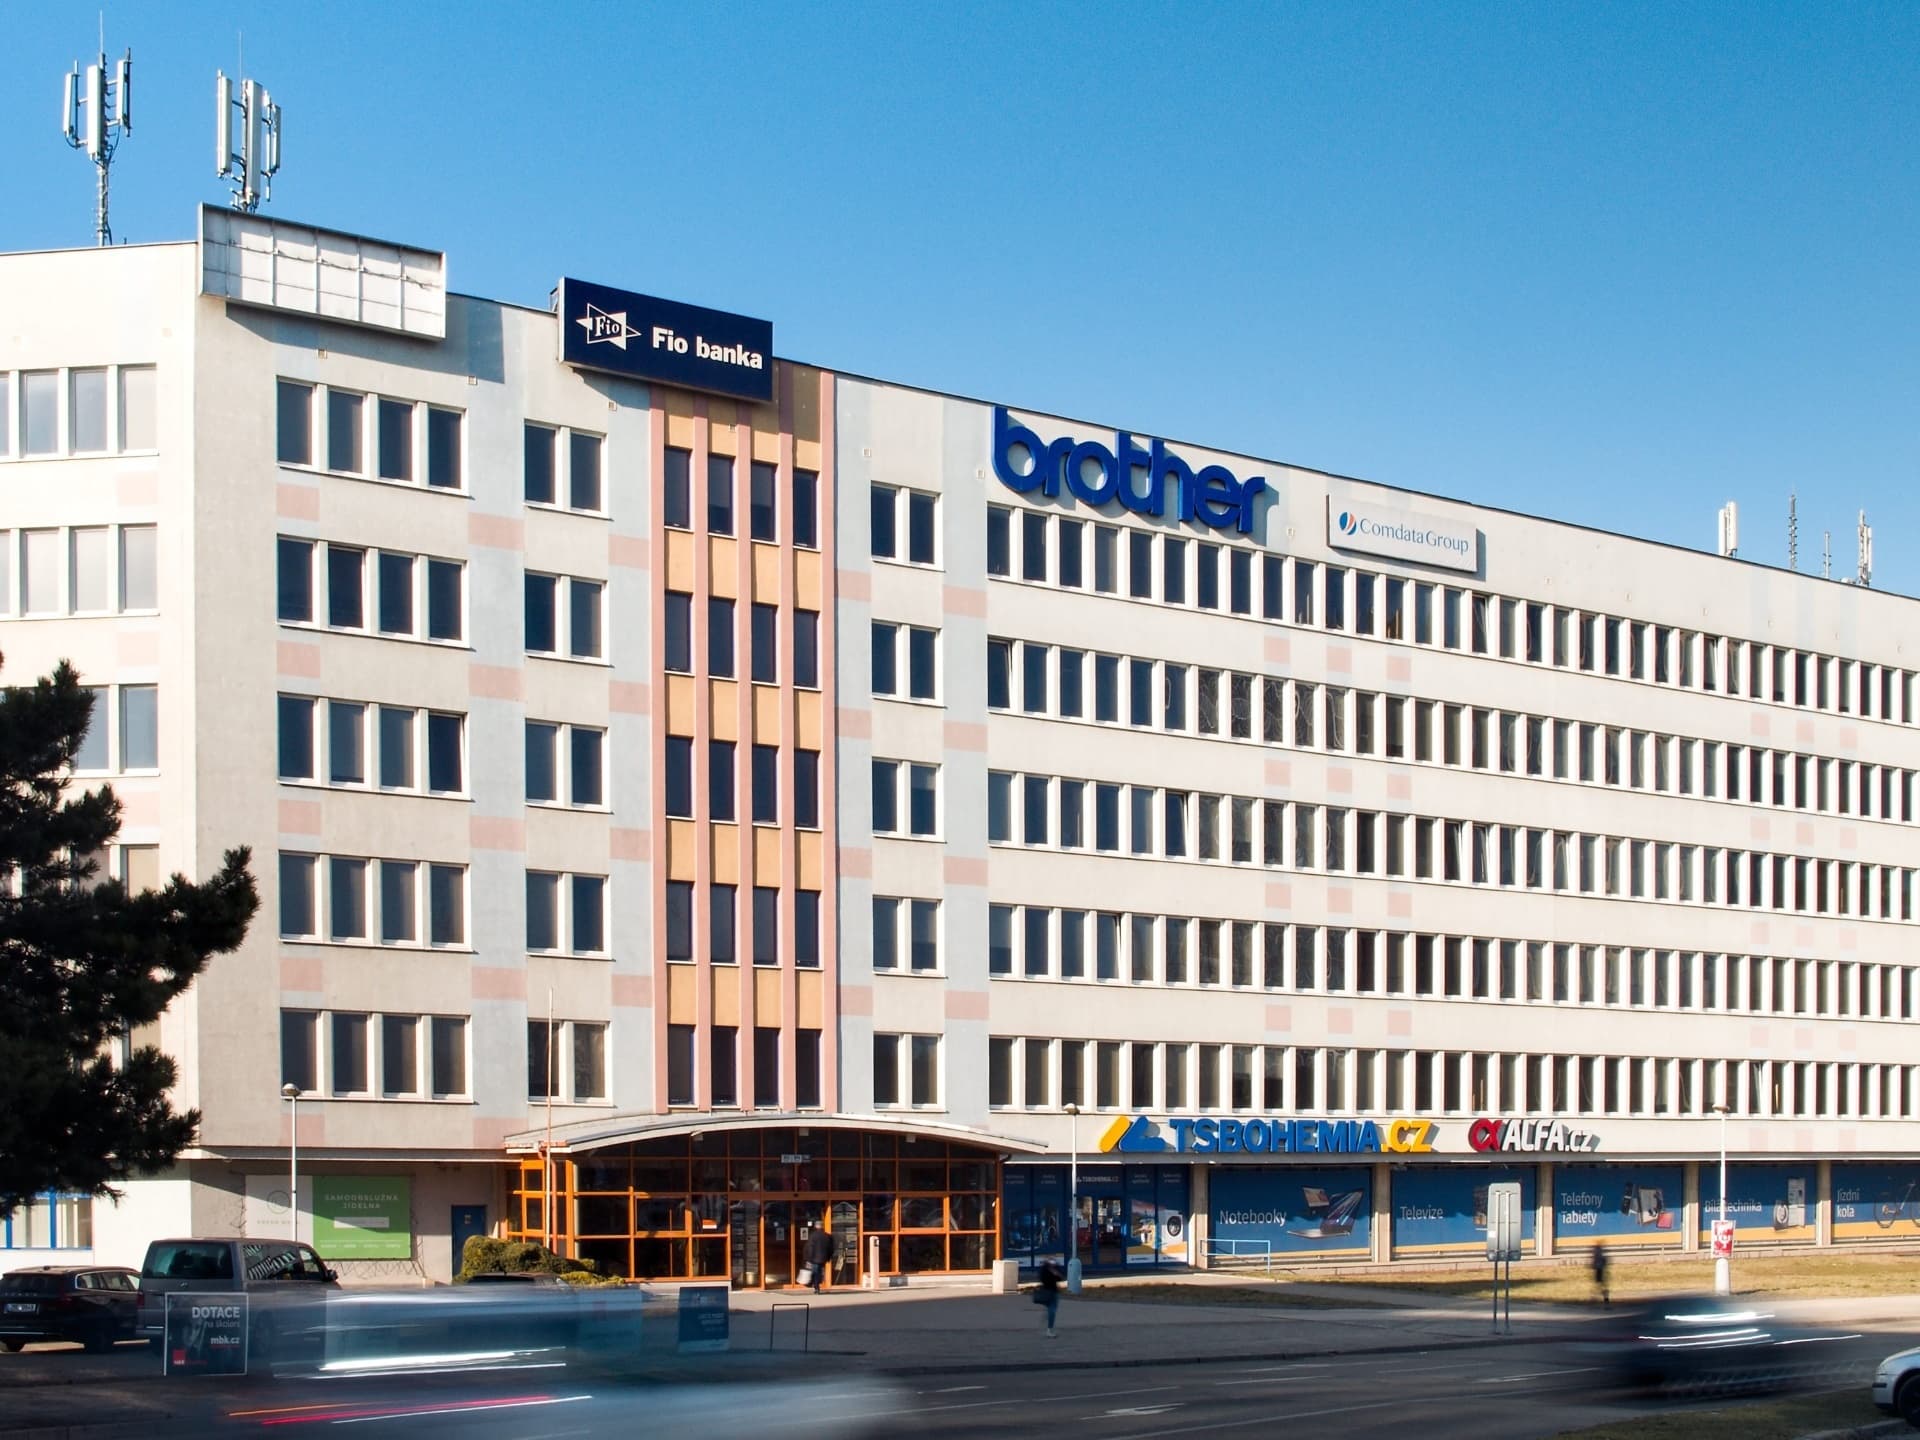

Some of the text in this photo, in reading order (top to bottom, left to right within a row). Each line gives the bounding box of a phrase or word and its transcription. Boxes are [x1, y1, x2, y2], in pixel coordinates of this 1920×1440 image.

[594, 315, 620, 337] Fio
[652, 326, 763, 370] Fio banka
[993, 405, 1266, 534] brother
[1360, 518, 1469, 555] Comdata Group
[1168, 1118, 1432, 1153] TSBOHEMIA.CZ
[1560, 1192, 1603, 1208] Telefony
[1219, 1208, 1287, 1227] Notebooky
[1400, 1204, 1443, 1220] Televize
[1561, 1209, 1597, 1226] Tablety
[1837, 1205, 1855, 1218] kola
[191, 1306, 240, 1319] DOTACE
[210, 1335, 240, 1345] mbk.cz
